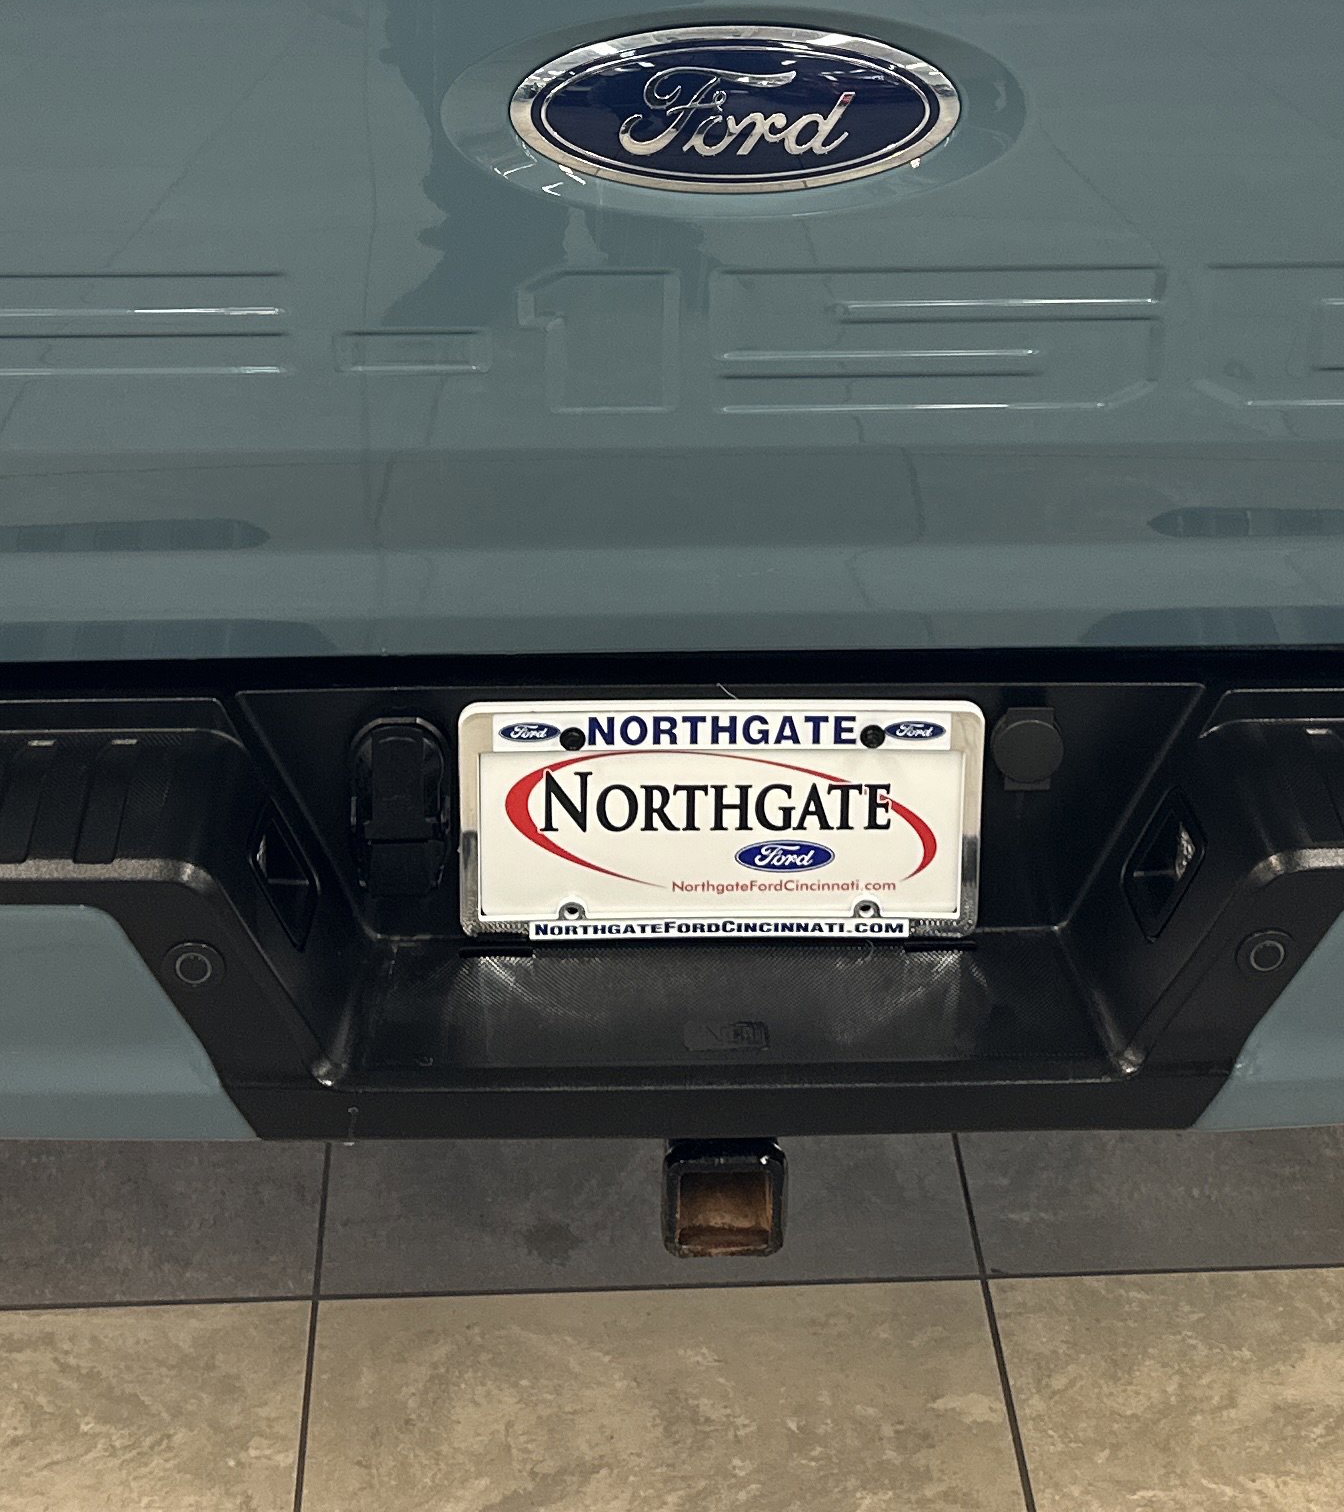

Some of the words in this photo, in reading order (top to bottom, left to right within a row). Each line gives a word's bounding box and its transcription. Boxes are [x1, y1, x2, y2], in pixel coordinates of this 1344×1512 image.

[619, 66, 855, 156] Ford
[510, 725, 548, 739] Ford
[587, 715, 857, 746] NORTHGATE
[895, 722, 933, 737] Ford
[540, 770, 892, 833] NORTHGATE
[754, 844, 815, 866] Ford
[672, 879, 896, 894] NorthgateFordCincinnati.com
